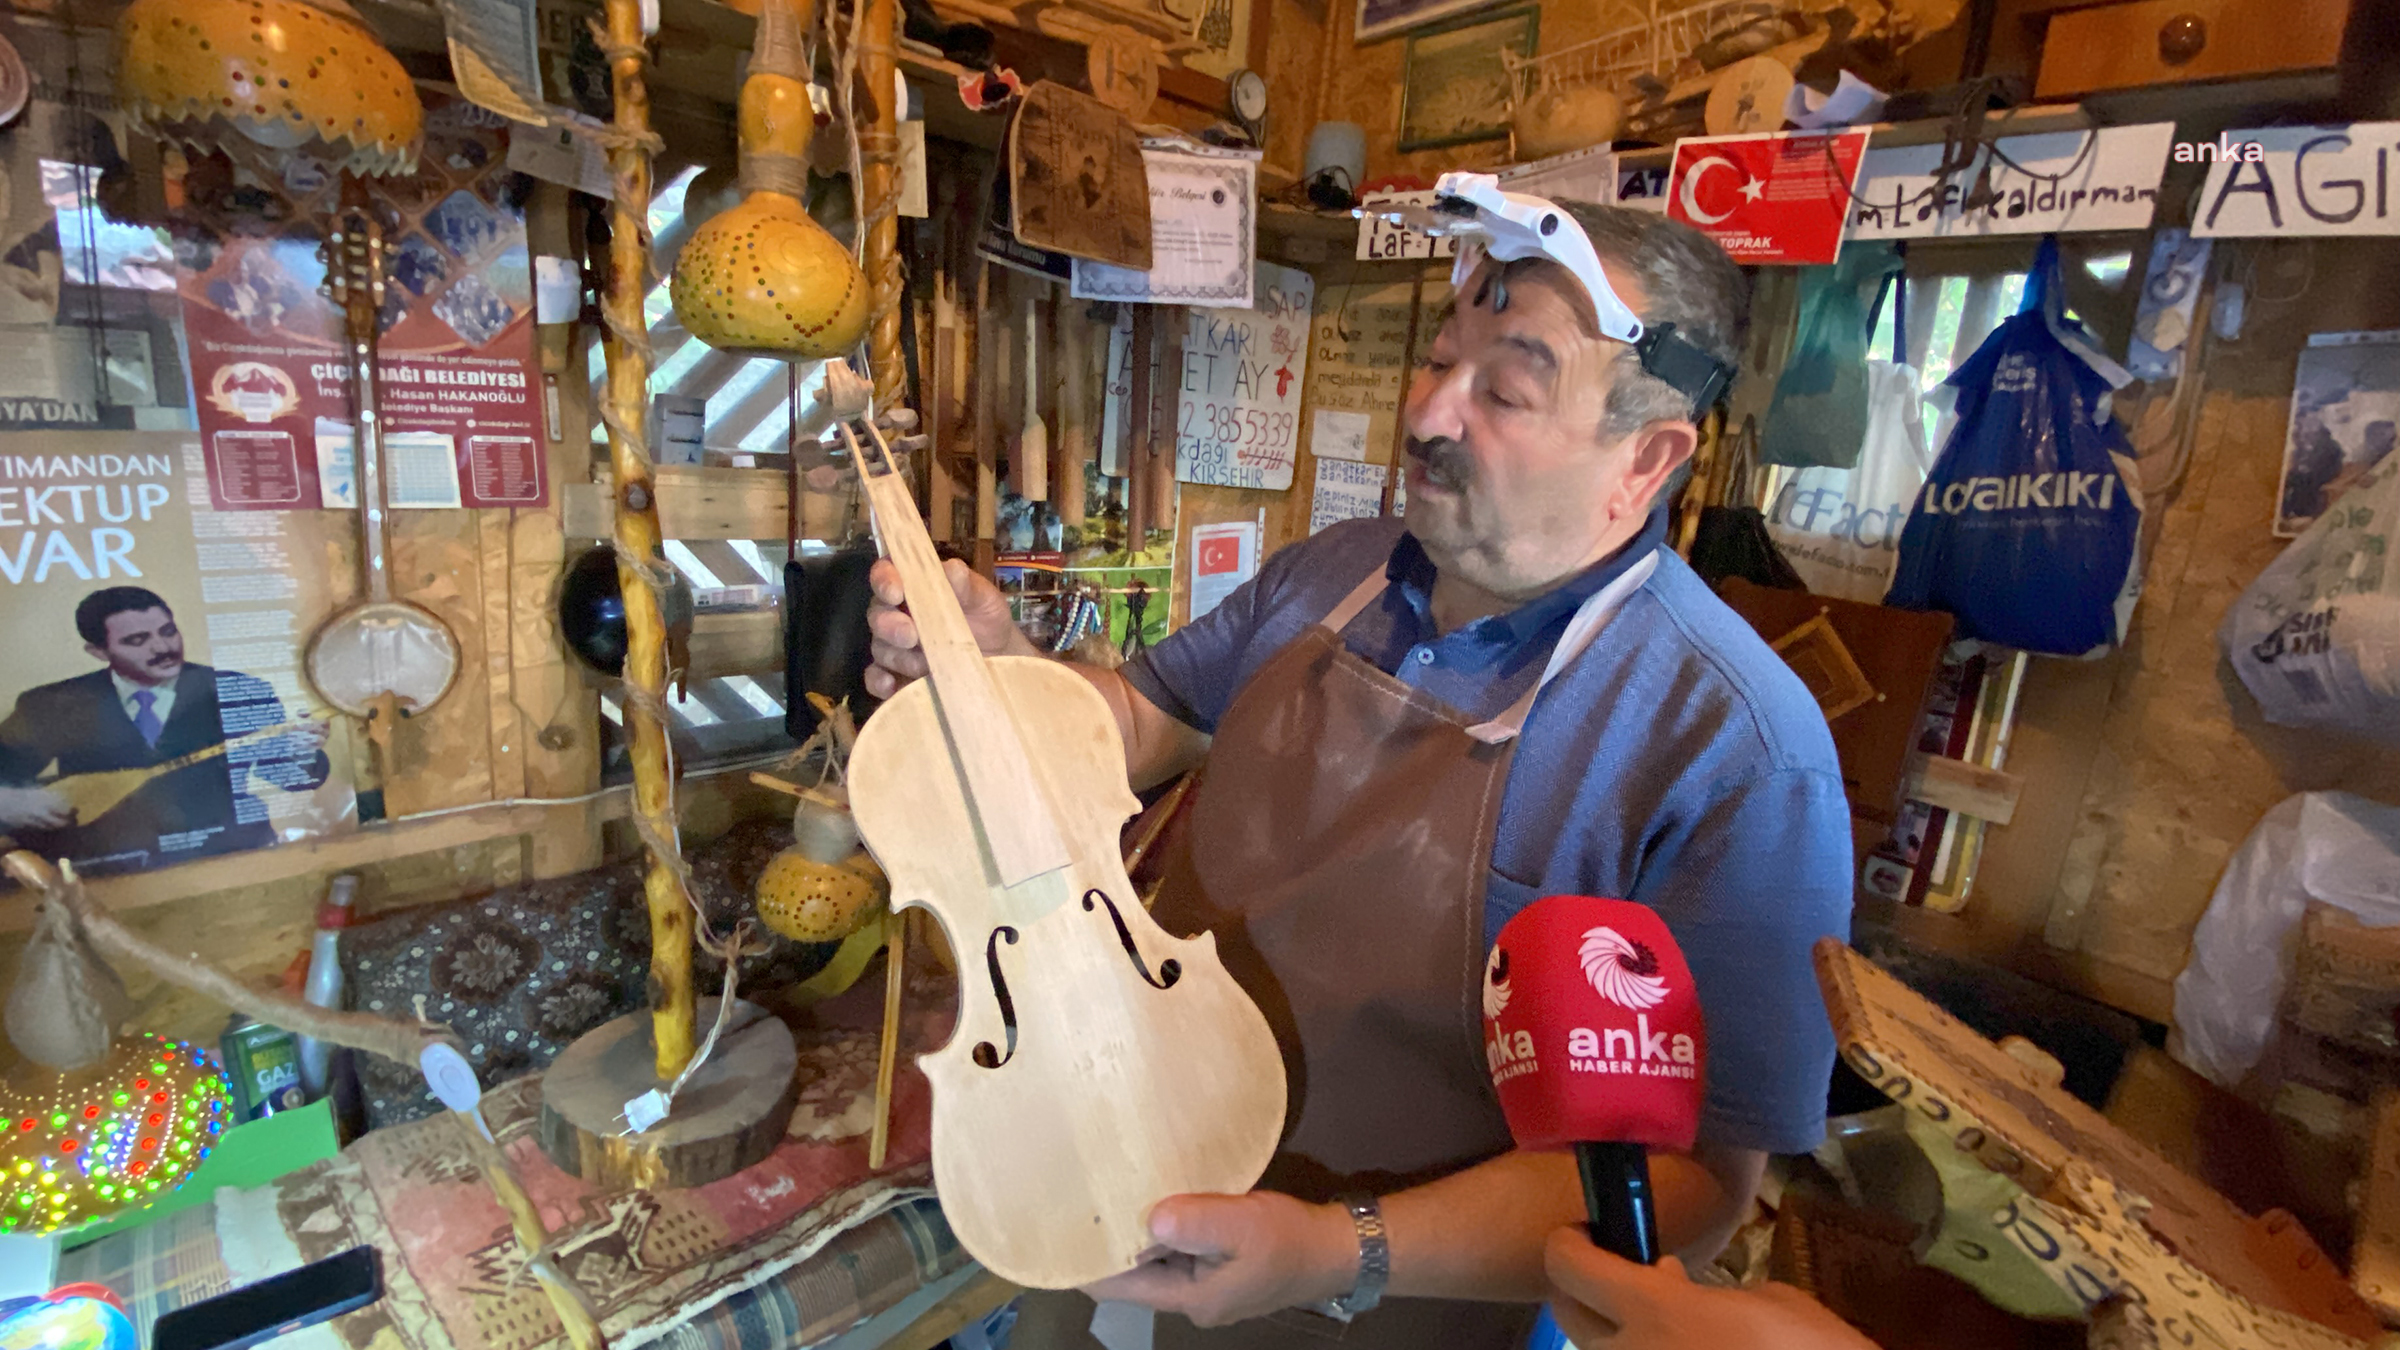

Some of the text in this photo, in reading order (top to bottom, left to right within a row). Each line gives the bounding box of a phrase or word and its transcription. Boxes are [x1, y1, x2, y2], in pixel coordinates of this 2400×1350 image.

[1720, 237, 1772, 249] TOPRAK
[424, 369, 526, 388] BELEDİYESİ
[1233, 359, 1268, 401] AY
[390, 387, 435, 400] Hasan
[438, 389, 526, 404] HAKANOĞLU
[1205, 402, 1293, 448] 3855339
[1487, 1013, 1695, 1073] nka anka
[256, 1062, 295, 1087] GAZ
[1569, 1059, 1696, 1080] HABER AJANSI
